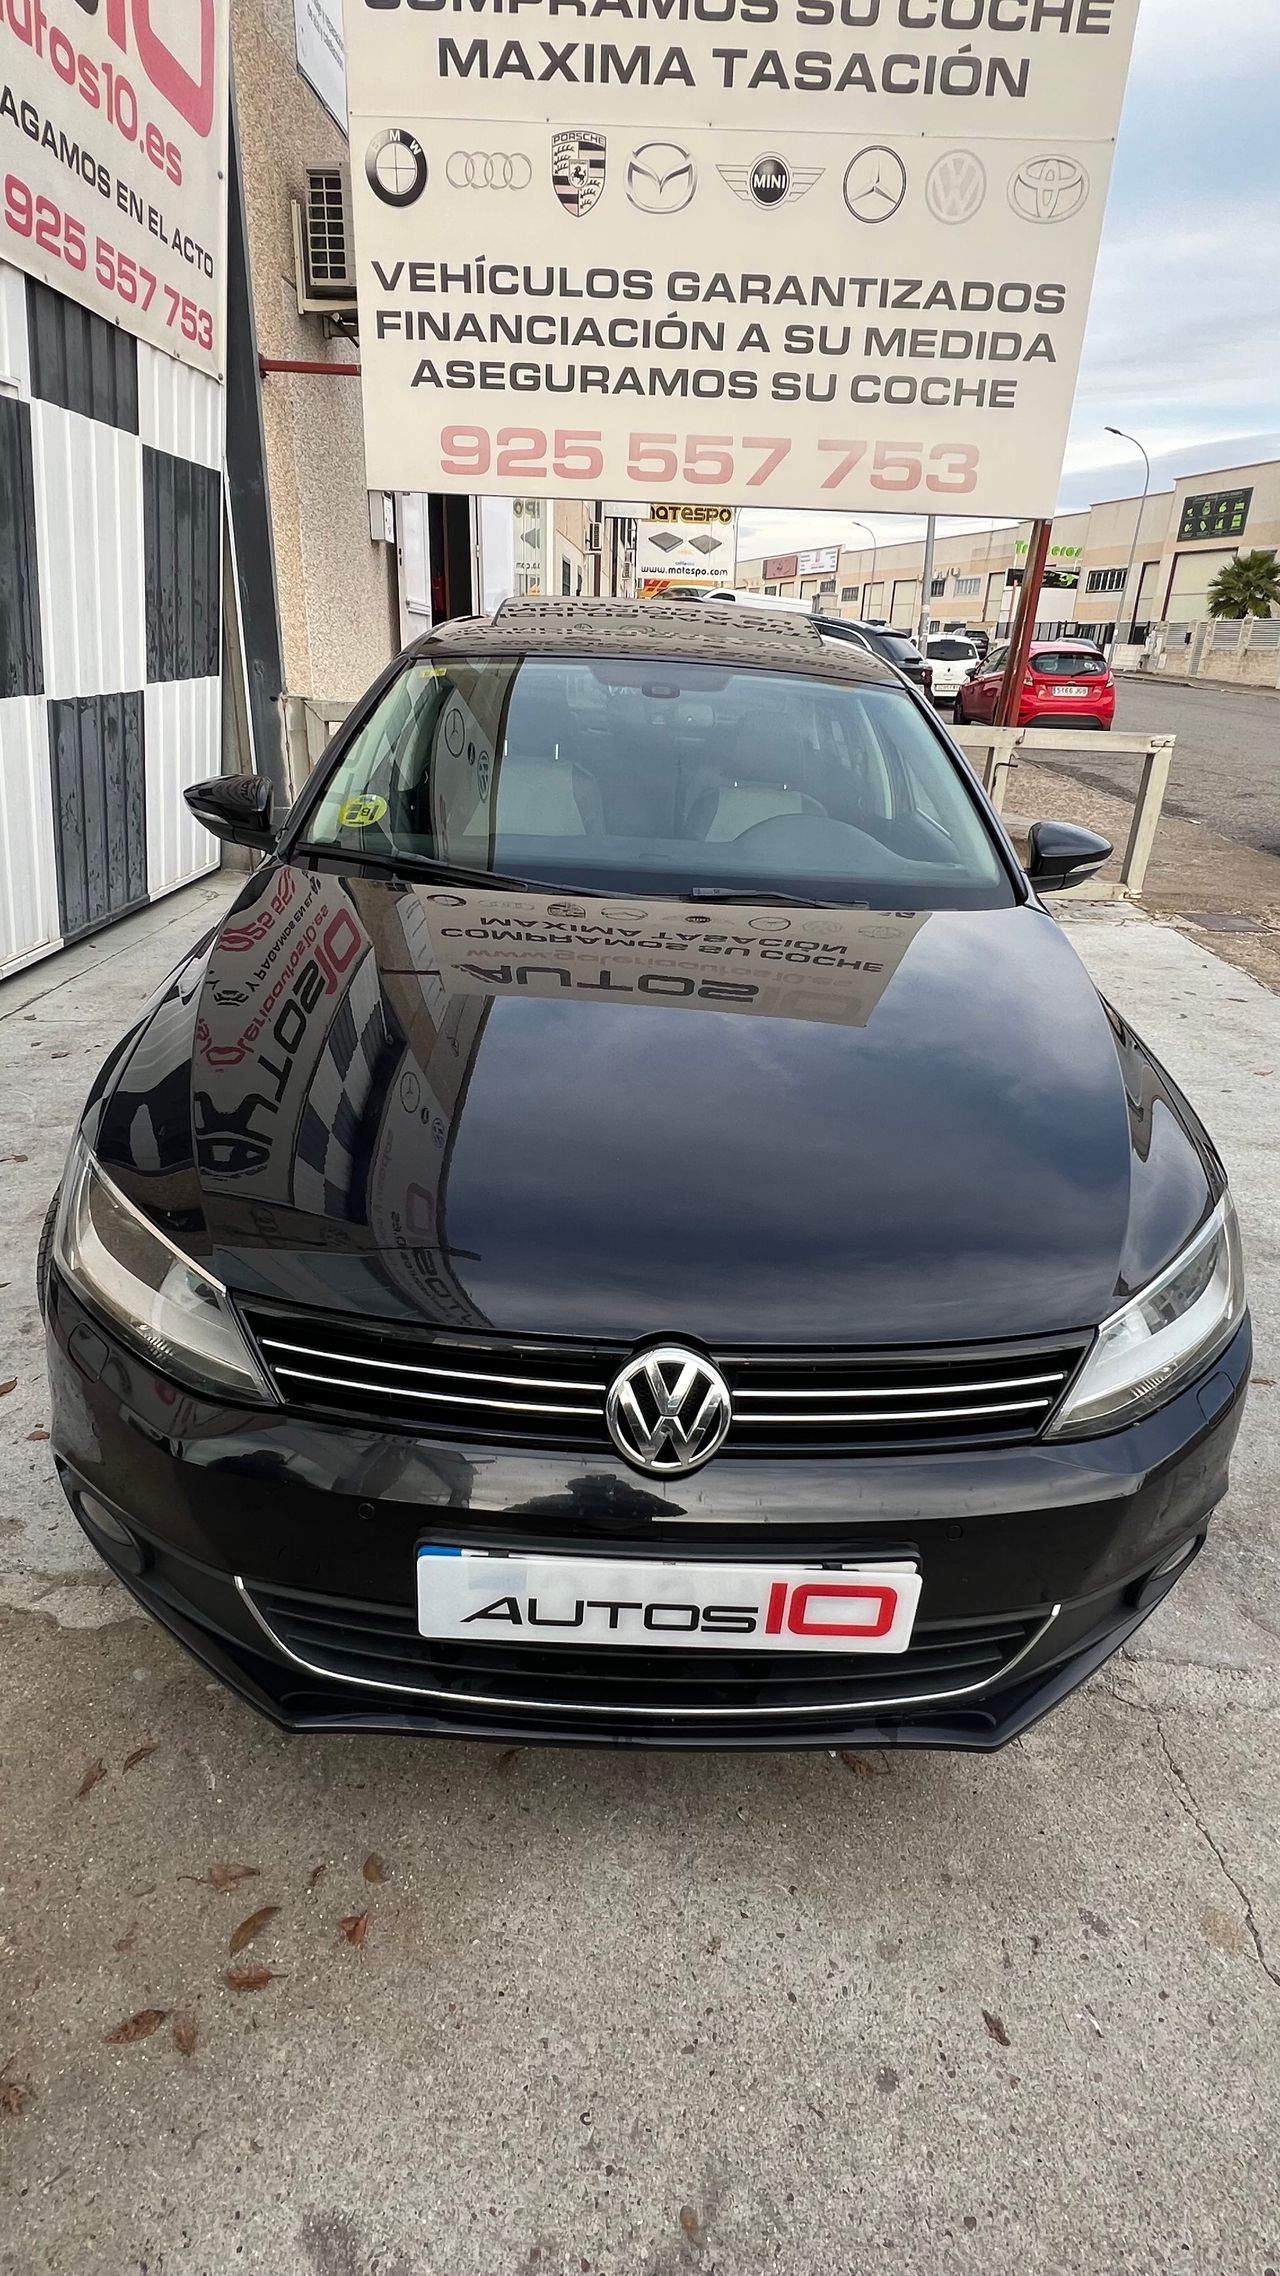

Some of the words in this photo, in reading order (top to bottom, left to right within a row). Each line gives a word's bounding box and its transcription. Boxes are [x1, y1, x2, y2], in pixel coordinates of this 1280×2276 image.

[899, 0, 1112, 35] COCHE
[437, 37, 696, 87] MAXIMA
[712, 43, 1031, 98] TASACIÓN
[553, 132, 605, 146] PORSCHE
[753, 174, 786, 190] MINI
[116, 178, 144, 226] EN
[148, 204, 168, 245] EL
[171, 227, 214, 279] ACTO
[3, 173, 88, 272] 925
[95, 235, 157, 312] 557
[164, 283, 214, 351] 753
[370, 254, 653, 300] VEHÍCULOS
[667, 271, 1066, 315] GARANTIZADOS
[376, 310, 725, 352] FINANCIACIÓN
[737, 322, 771, 353] A
[784, 324, 852, 356] SU
[863, 326, 1057, 363] MEDIDA
[410, 359, 758, 401] ASEGURAMOS
[771, 371, 838, 402] SU
[850, 374, 1018, 410] COCHE
[439, 424, 605, 480] 925
[626, 431, 793, 487] 557
[817, 438, 980, 493] 753
[640, 565, 728, 578] www.matespo.com
[460, 1582, 898, 1637] AUTOS10
